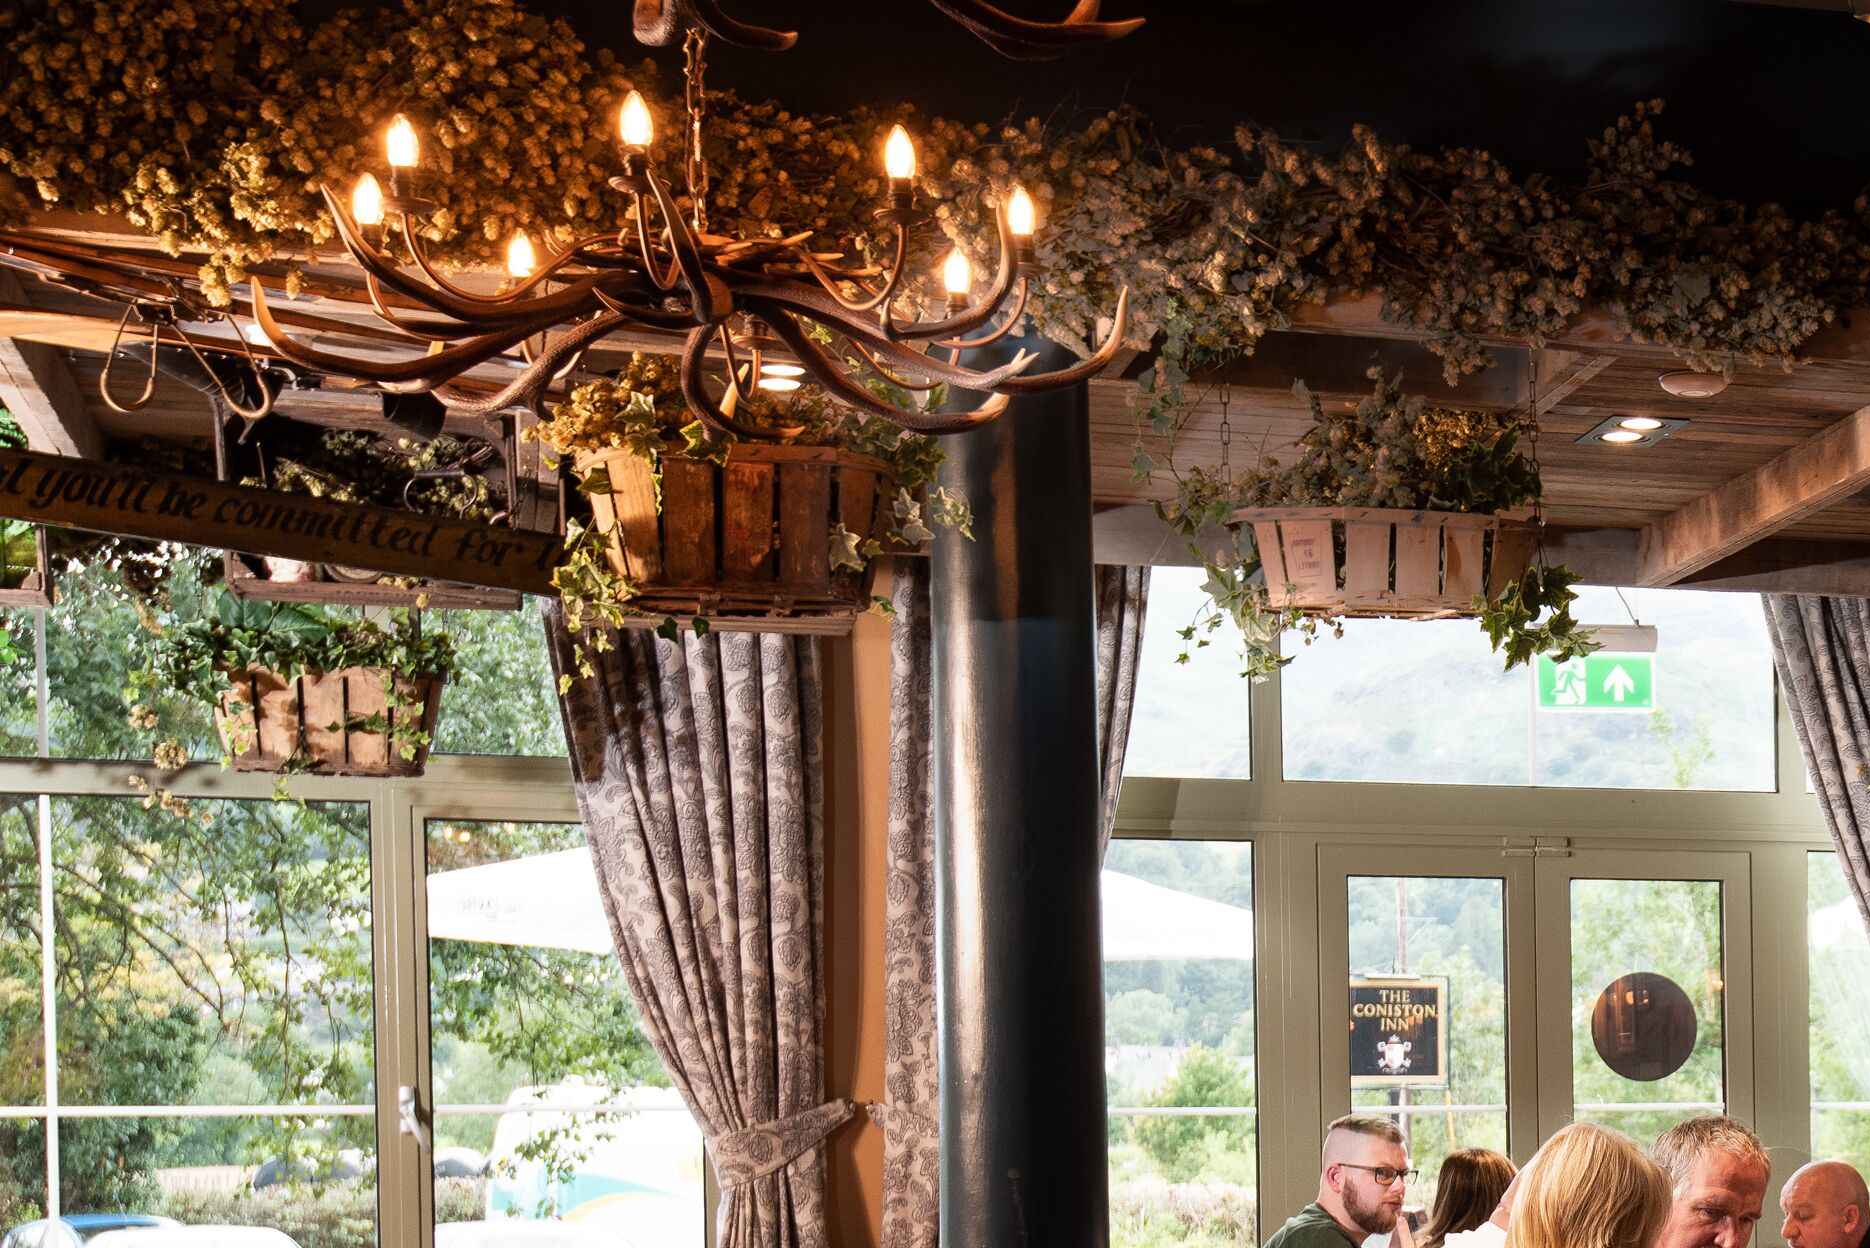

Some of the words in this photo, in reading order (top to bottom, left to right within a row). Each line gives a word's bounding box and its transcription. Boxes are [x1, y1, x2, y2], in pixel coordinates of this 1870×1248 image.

[157, 482, 208, 520] be
[455, 526, 525, 567] for
[1379, 989, 1411, 1003] THE
[1352, 1003, 1437, 1018] CONISTON
[1380, 1017, 1410, 1032] INN
